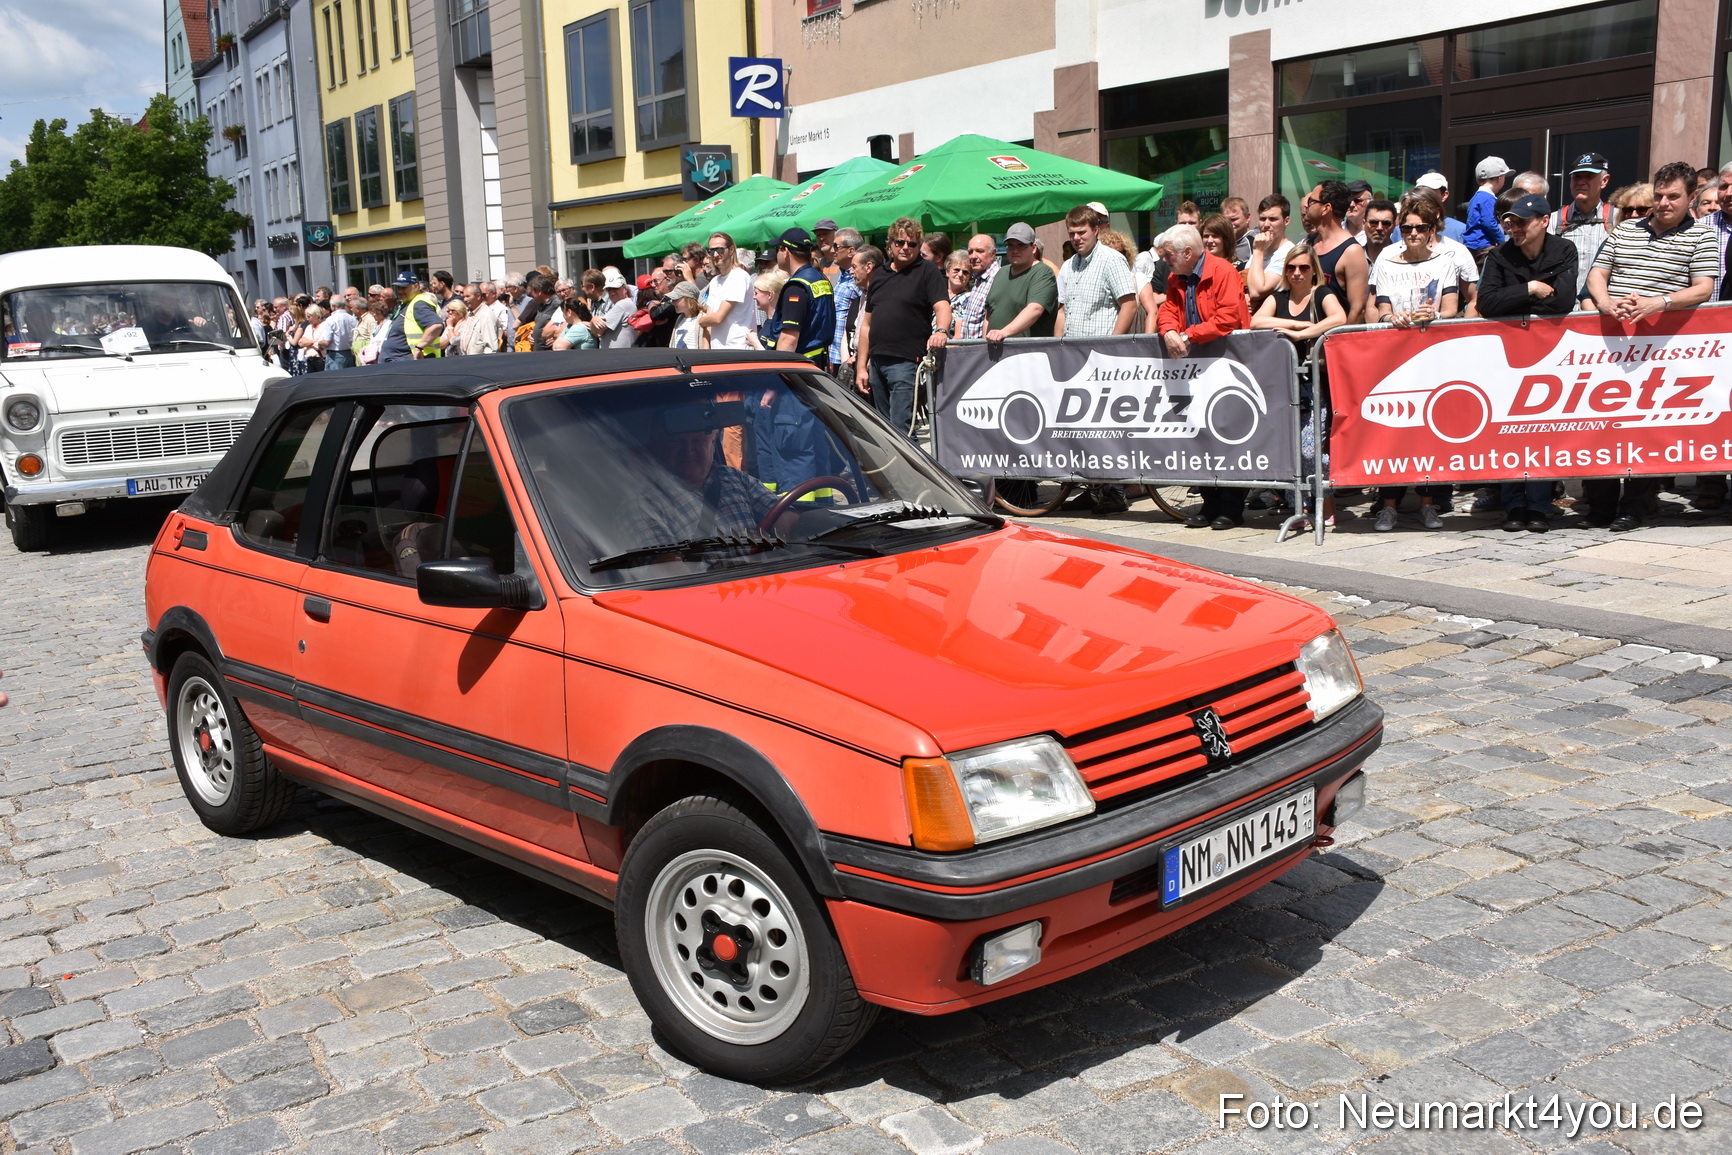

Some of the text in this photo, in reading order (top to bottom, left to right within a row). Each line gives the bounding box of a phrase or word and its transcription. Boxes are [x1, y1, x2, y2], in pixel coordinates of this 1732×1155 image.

[789, 127, 830, 146] Unterer Markt 15
[703, 160, 721, 183] G2
[992, 173, 1065, 183] Neumarkter
[986, 178, 1089, 191] Lammsbräu
[1196, 189, 1222, 198] GARTEN
[1200, 198, 1219, 206] BUCH
[1555, 339, 1726, 367] Autoklassik
[1086, 363, 1202, 382] Autoklassik
[1506, 366, 1715, 417] Dietz
[108, 404, 208, 418] FORD
[1055, 385, 1195, 424] Dietz
[1050, 430, 1126, 439] BREITENBRUNN
[1497, 420, 1610, 435] BREITENBRUNN
[960, 450, 1270, 470] www.autoklassik-dietz.de
[135, 478, 160, 493] LAU
[167, 476, 183, 490] TR
[1302, 791, 1312, 806] 04
[1302, 819, 1312, 832] 10
[1181, 799, 1298, 889] NM NN 143
[1168, 879, 1176, 892] D
